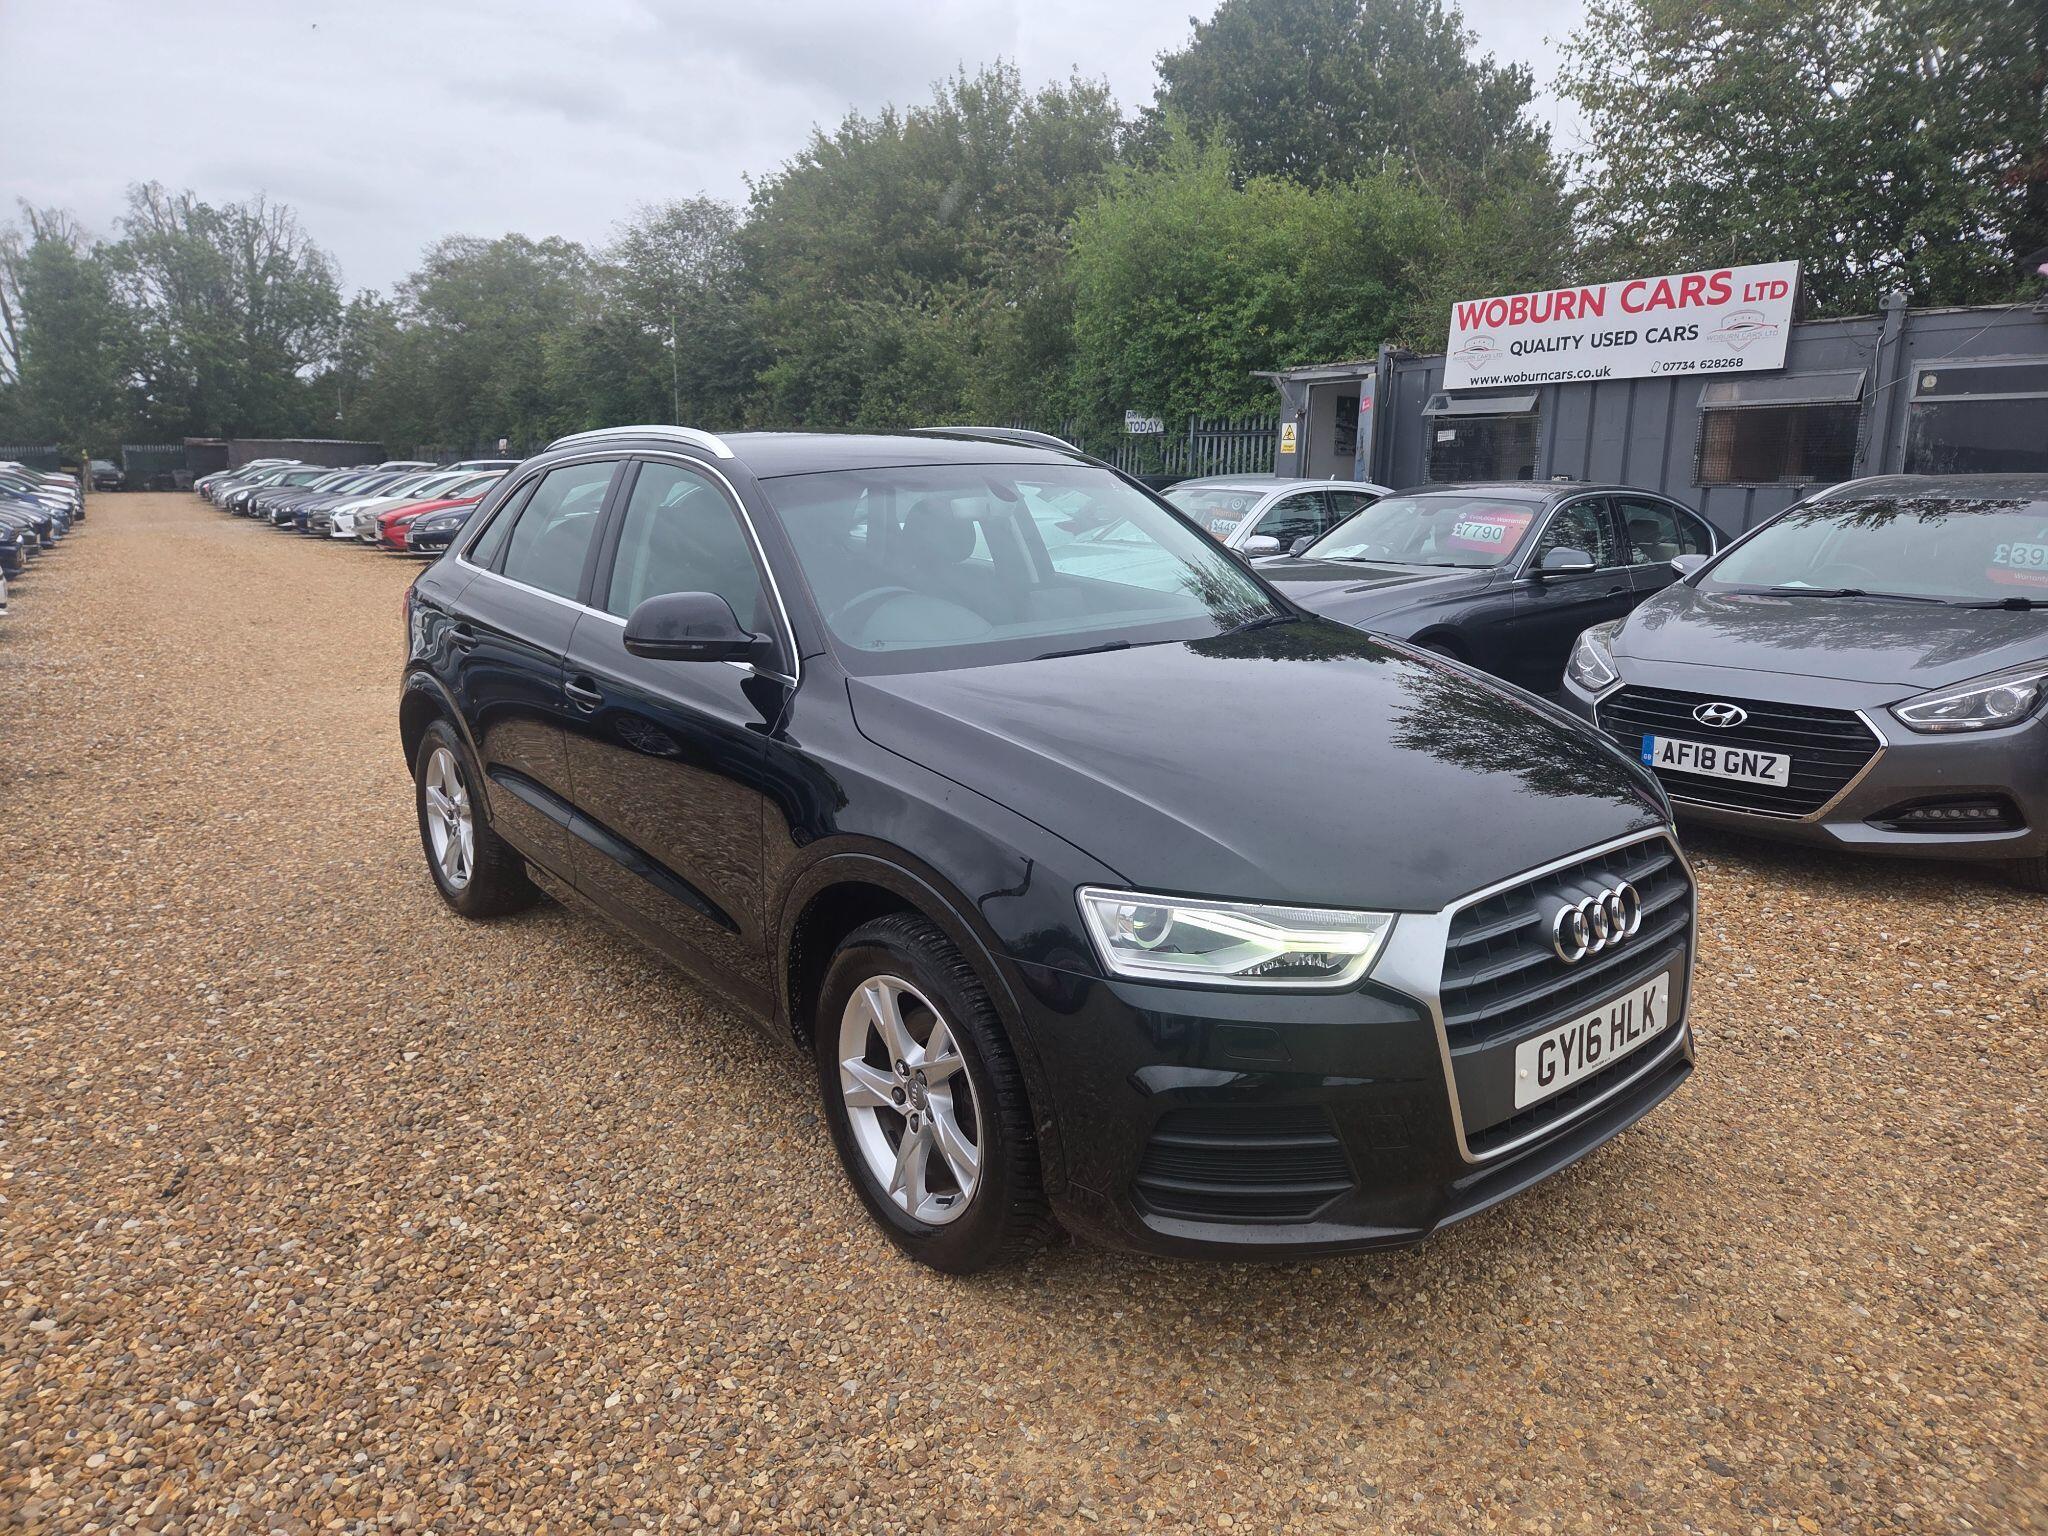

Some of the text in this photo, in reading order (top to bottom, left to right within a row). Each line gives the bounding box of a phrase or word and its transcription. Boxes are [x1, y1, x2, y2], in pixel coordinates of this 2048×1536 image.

[1457, 271, 1789, 331] WOBURN CARS LTD
[1509, 324, 1699, 356] QUALITY USED CARS
[1470, 366, 1611, 385] www.woburncars.co.uk
[1662, 358, 1744, 371] 07734 628268
[1129, 421, 1160, 432] TODAY
[1451, 522, 1503, 541] £7790
[1993, 543, 2048, 566] £39
[1661, 741, 1777, 780] AF18 GNZ
[1537, 985, 1656, 1087] GY16 HLK
